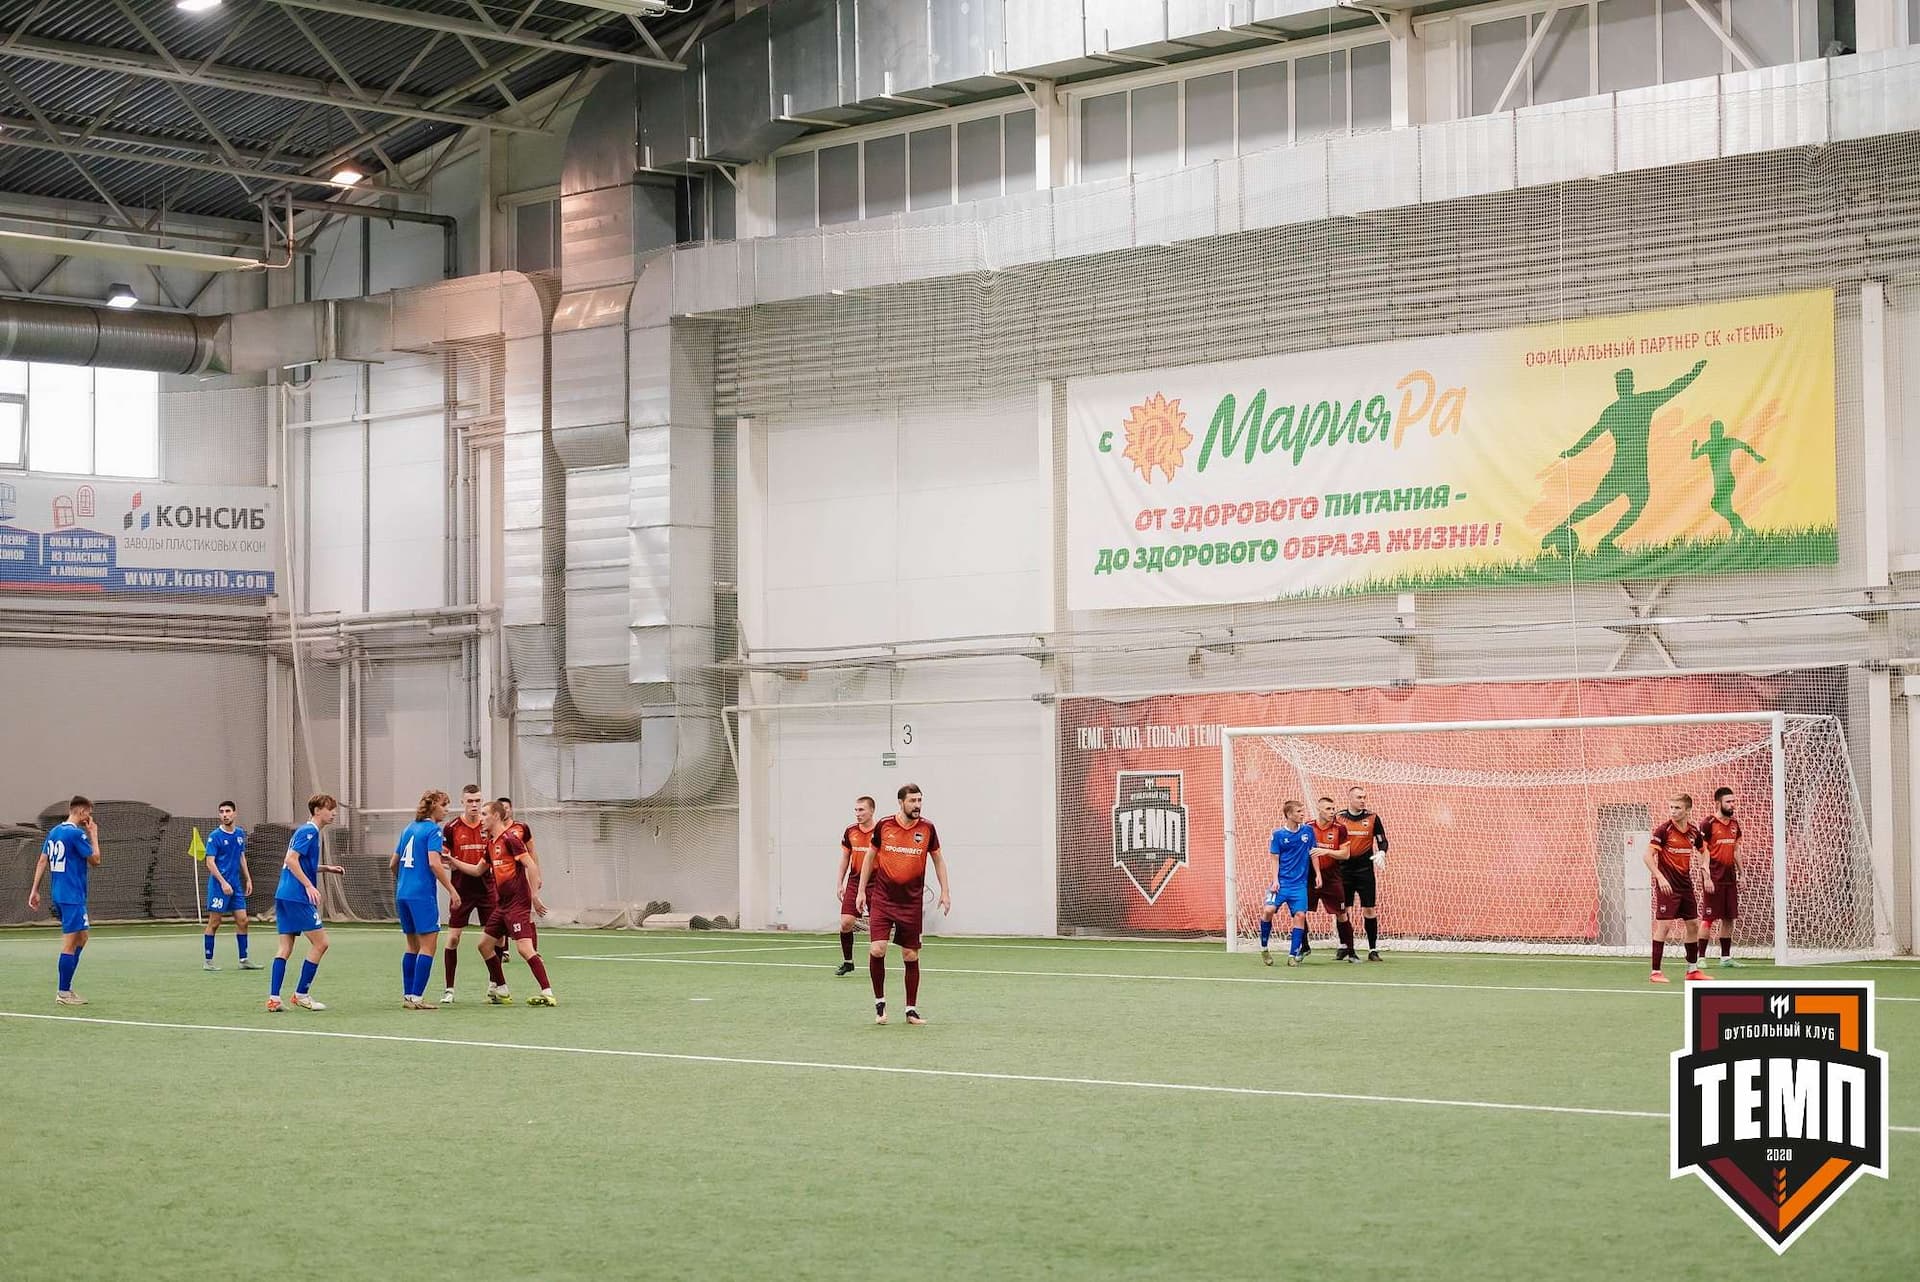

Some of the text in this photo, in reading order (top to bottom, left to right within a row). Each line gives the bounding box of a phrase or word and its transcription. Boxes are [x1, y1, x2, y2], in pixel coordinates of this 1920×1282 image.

[1525, 322, 1785, 368] ОФИЦИАЛЬНЫЙ ПАРТНЕР СК «ТЕМП»
[156, 505, 266, 530] КОНСИБ
[1135, 507, 1167, 531] ОТ
[1170, 496, 1320, 533] ЗДОРОВОГО
[1324, 484, 1451, 518] ПИТАНИЯ
[124, 537, 266, 553] ЗАВОДЫ ПЛАСТИКОВЫХ ОКОН
[1094, 547, 1130, 576] ДО
[1132, 538, 1279, 574] ЗДОРОВОГО
[1283, 530, 1382, 561] ОБРАЗА
[125, 569, 268, 588] www.konsib.com
[903, 724, 913, 745] 3
[1077, 726, 1108, 751] ТЕМП,
[1145, 723, 1190, 748] ТОЛЬКО
[1119, 808, 1181, 854] ТЕМП
[400, 835, 414, 868] 4
